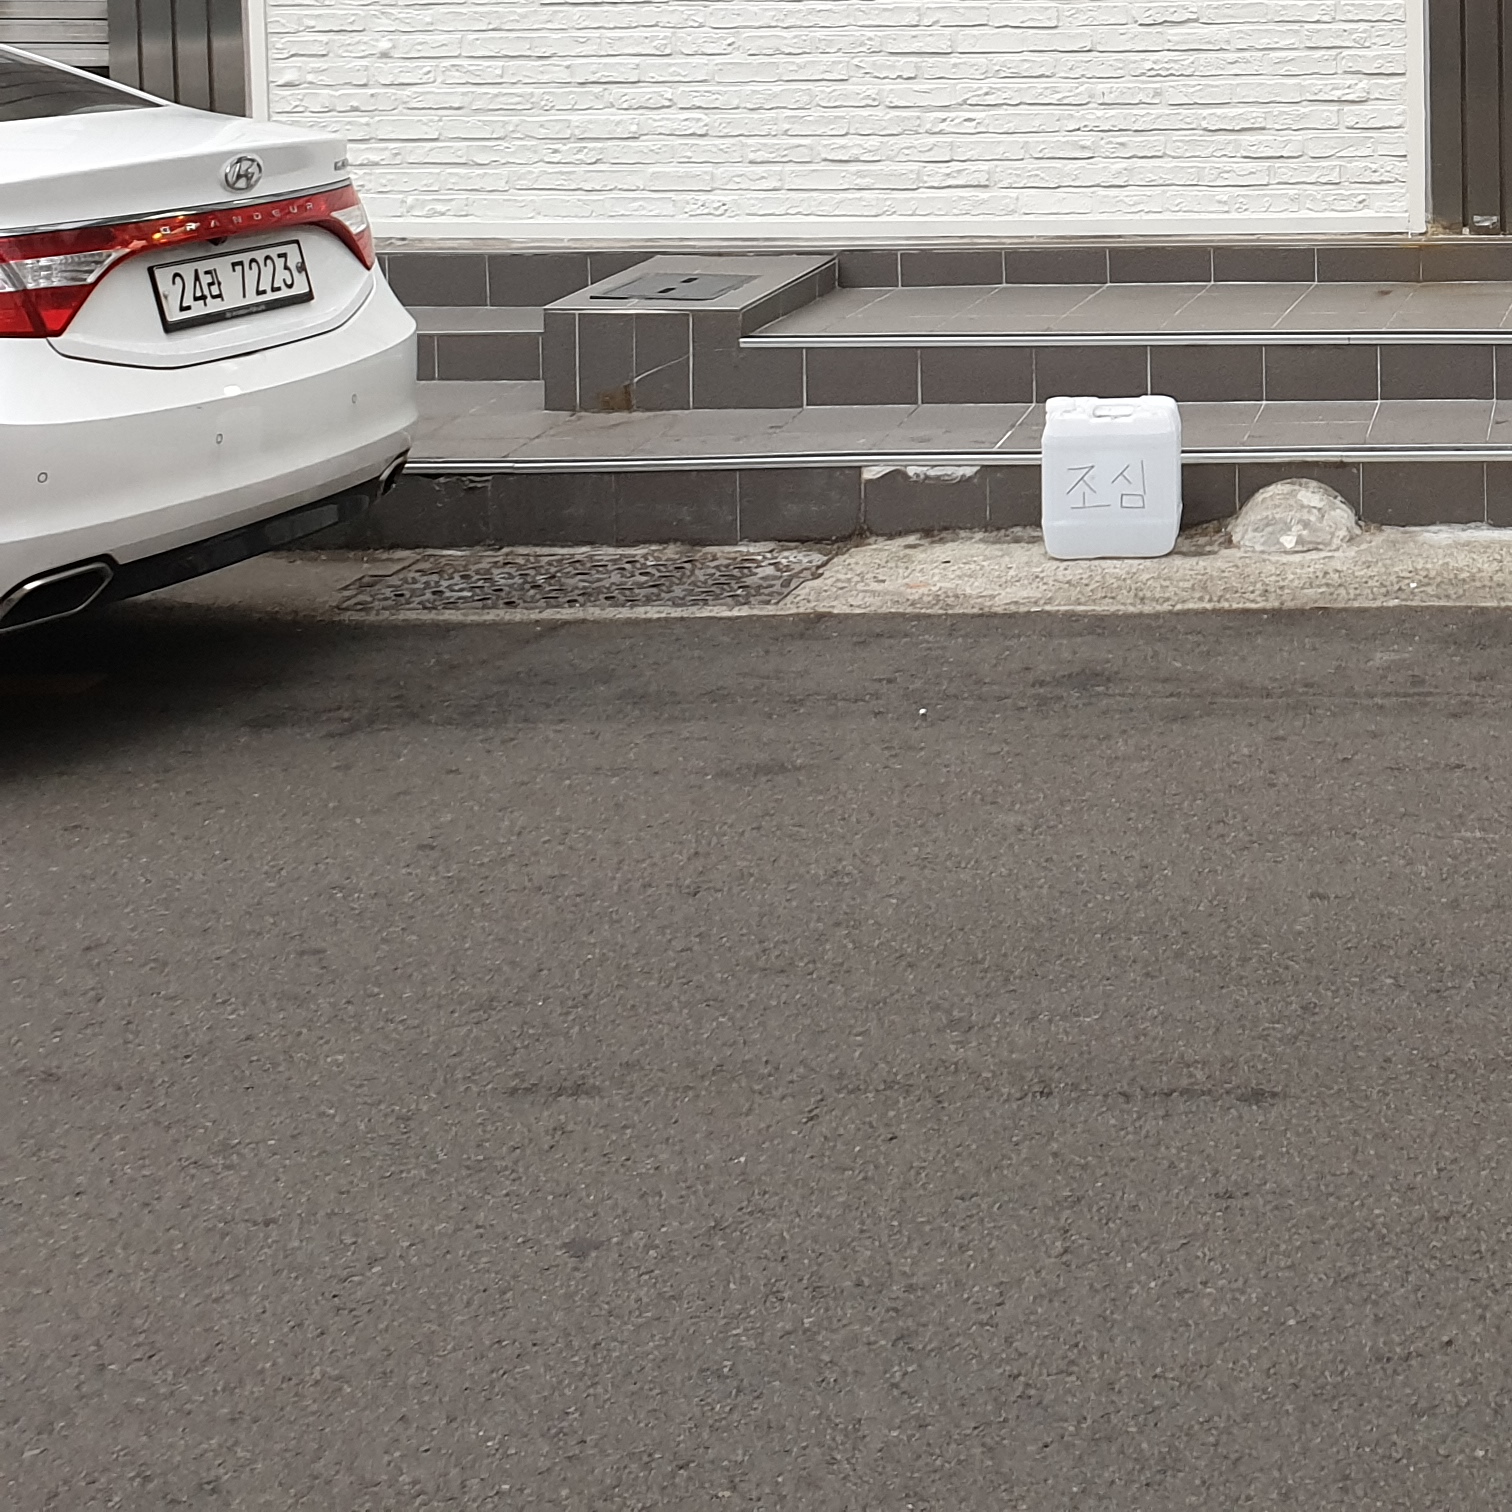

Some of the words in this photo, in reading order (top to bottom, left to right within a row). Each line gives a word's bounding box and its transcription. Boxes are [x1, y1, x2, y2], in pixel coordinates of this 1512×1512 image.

[159, 201, 314, 235] GRANDEUR
[231, 251, 295, 299] 7223
[1065, 459, 1147, 510] 조심
